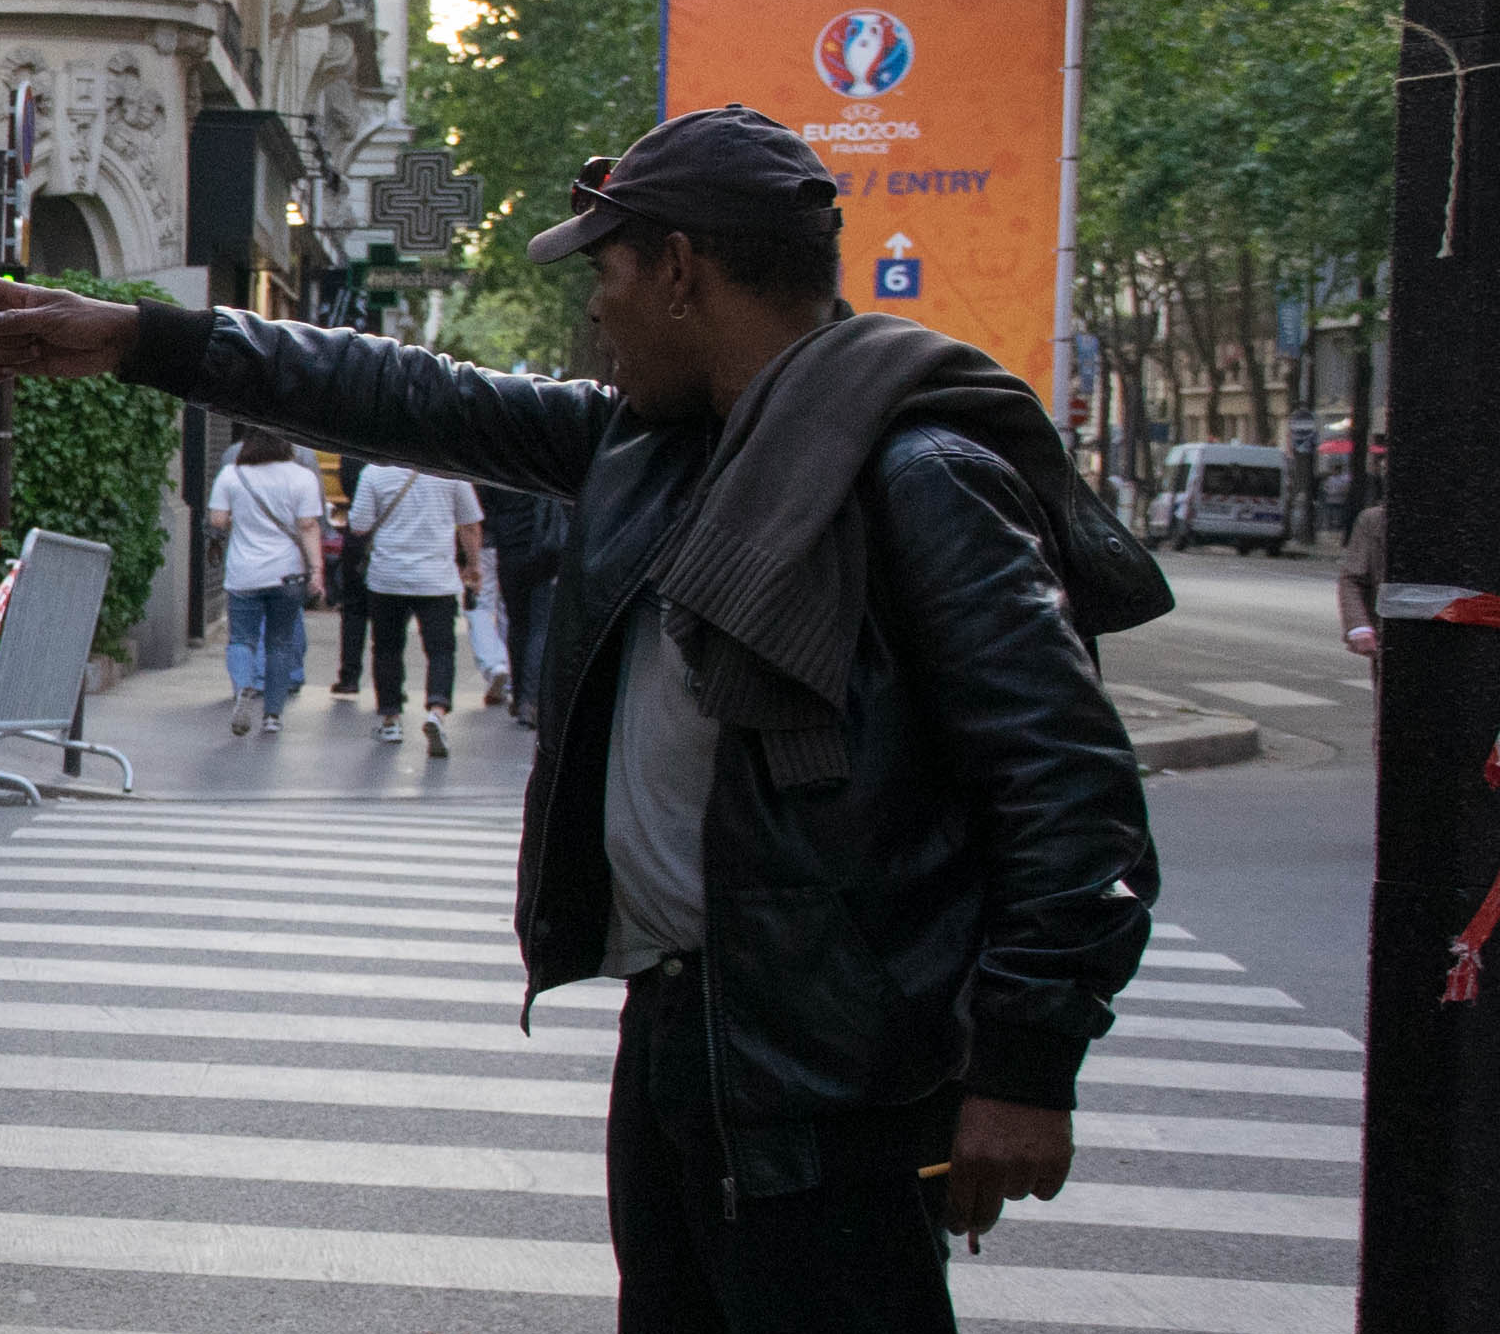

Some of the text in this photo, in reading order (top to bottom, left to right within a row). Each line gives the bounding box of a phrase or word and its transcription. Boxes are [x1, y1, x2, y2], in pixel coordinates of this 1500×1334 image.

[831, 142, 890, 155] FRANCE
[887, 168, 992, 196] ENTRY
[884, 264, 910, 292] 6
